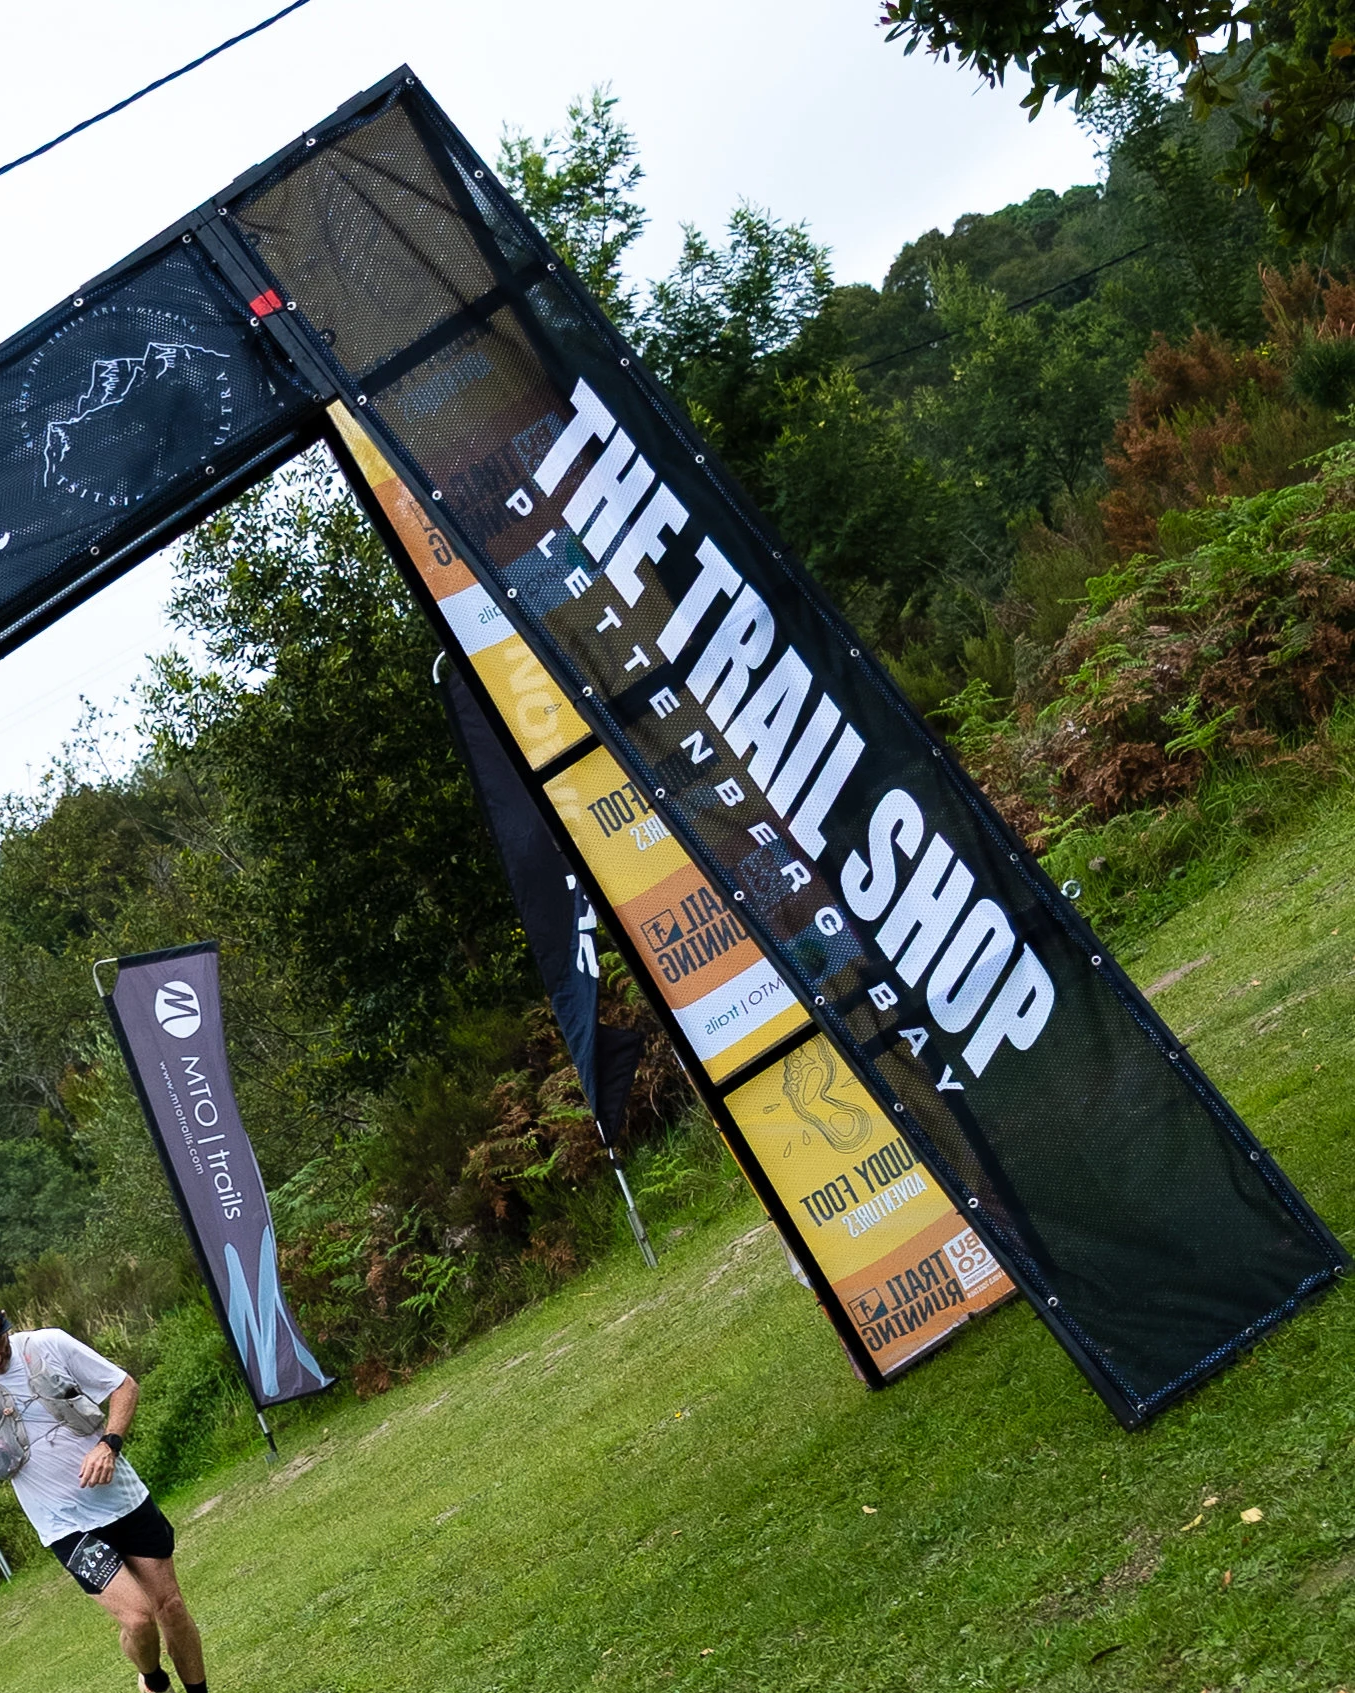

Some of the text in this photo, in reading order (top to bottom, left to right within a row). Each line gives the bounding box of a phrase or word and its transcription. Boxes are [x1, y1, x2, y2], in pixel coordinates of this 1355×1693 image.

[505, 487, 965, 1093] PLETTENBERG BAY
[533, 376, 1055, 1078] THE TRAIL SHOP
[158, 1060, 204, 1176] www.mtotrails.com
[180, 1056, 243, 1220] MTO trails
